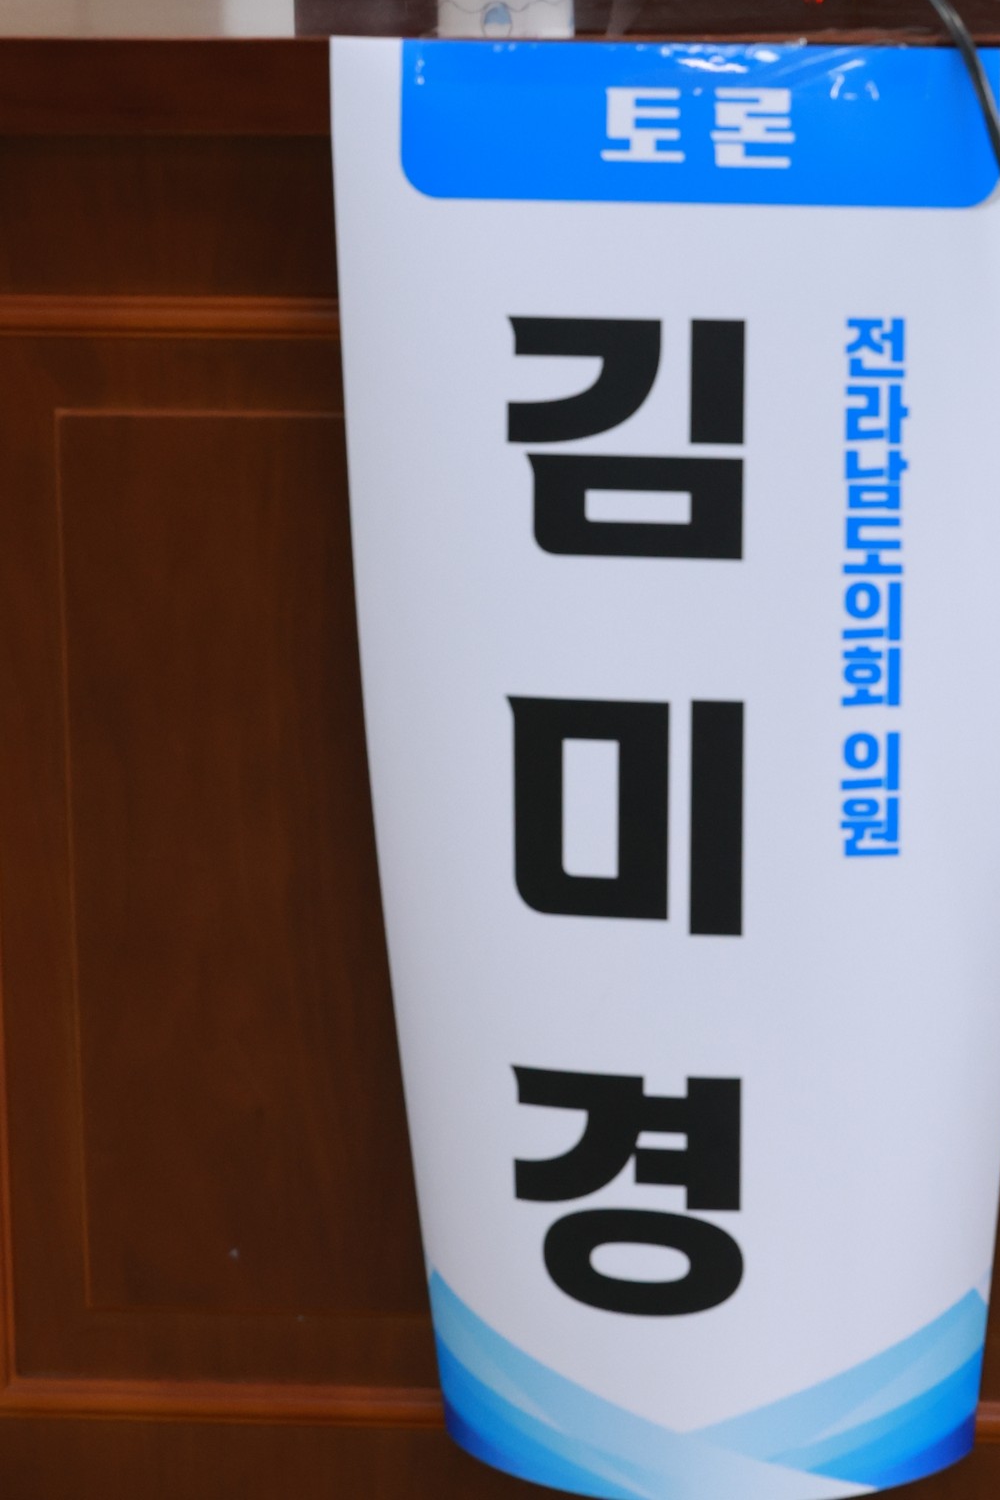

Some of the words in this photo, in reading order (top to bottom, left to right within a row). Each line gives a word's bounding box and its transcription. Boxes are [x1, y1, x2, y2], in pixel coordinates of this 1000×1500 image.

[602, 87, 795, 168] 토론
[840, 317, 909, 707] 전라남도의회
[840, 732, 901, 857] 의원
